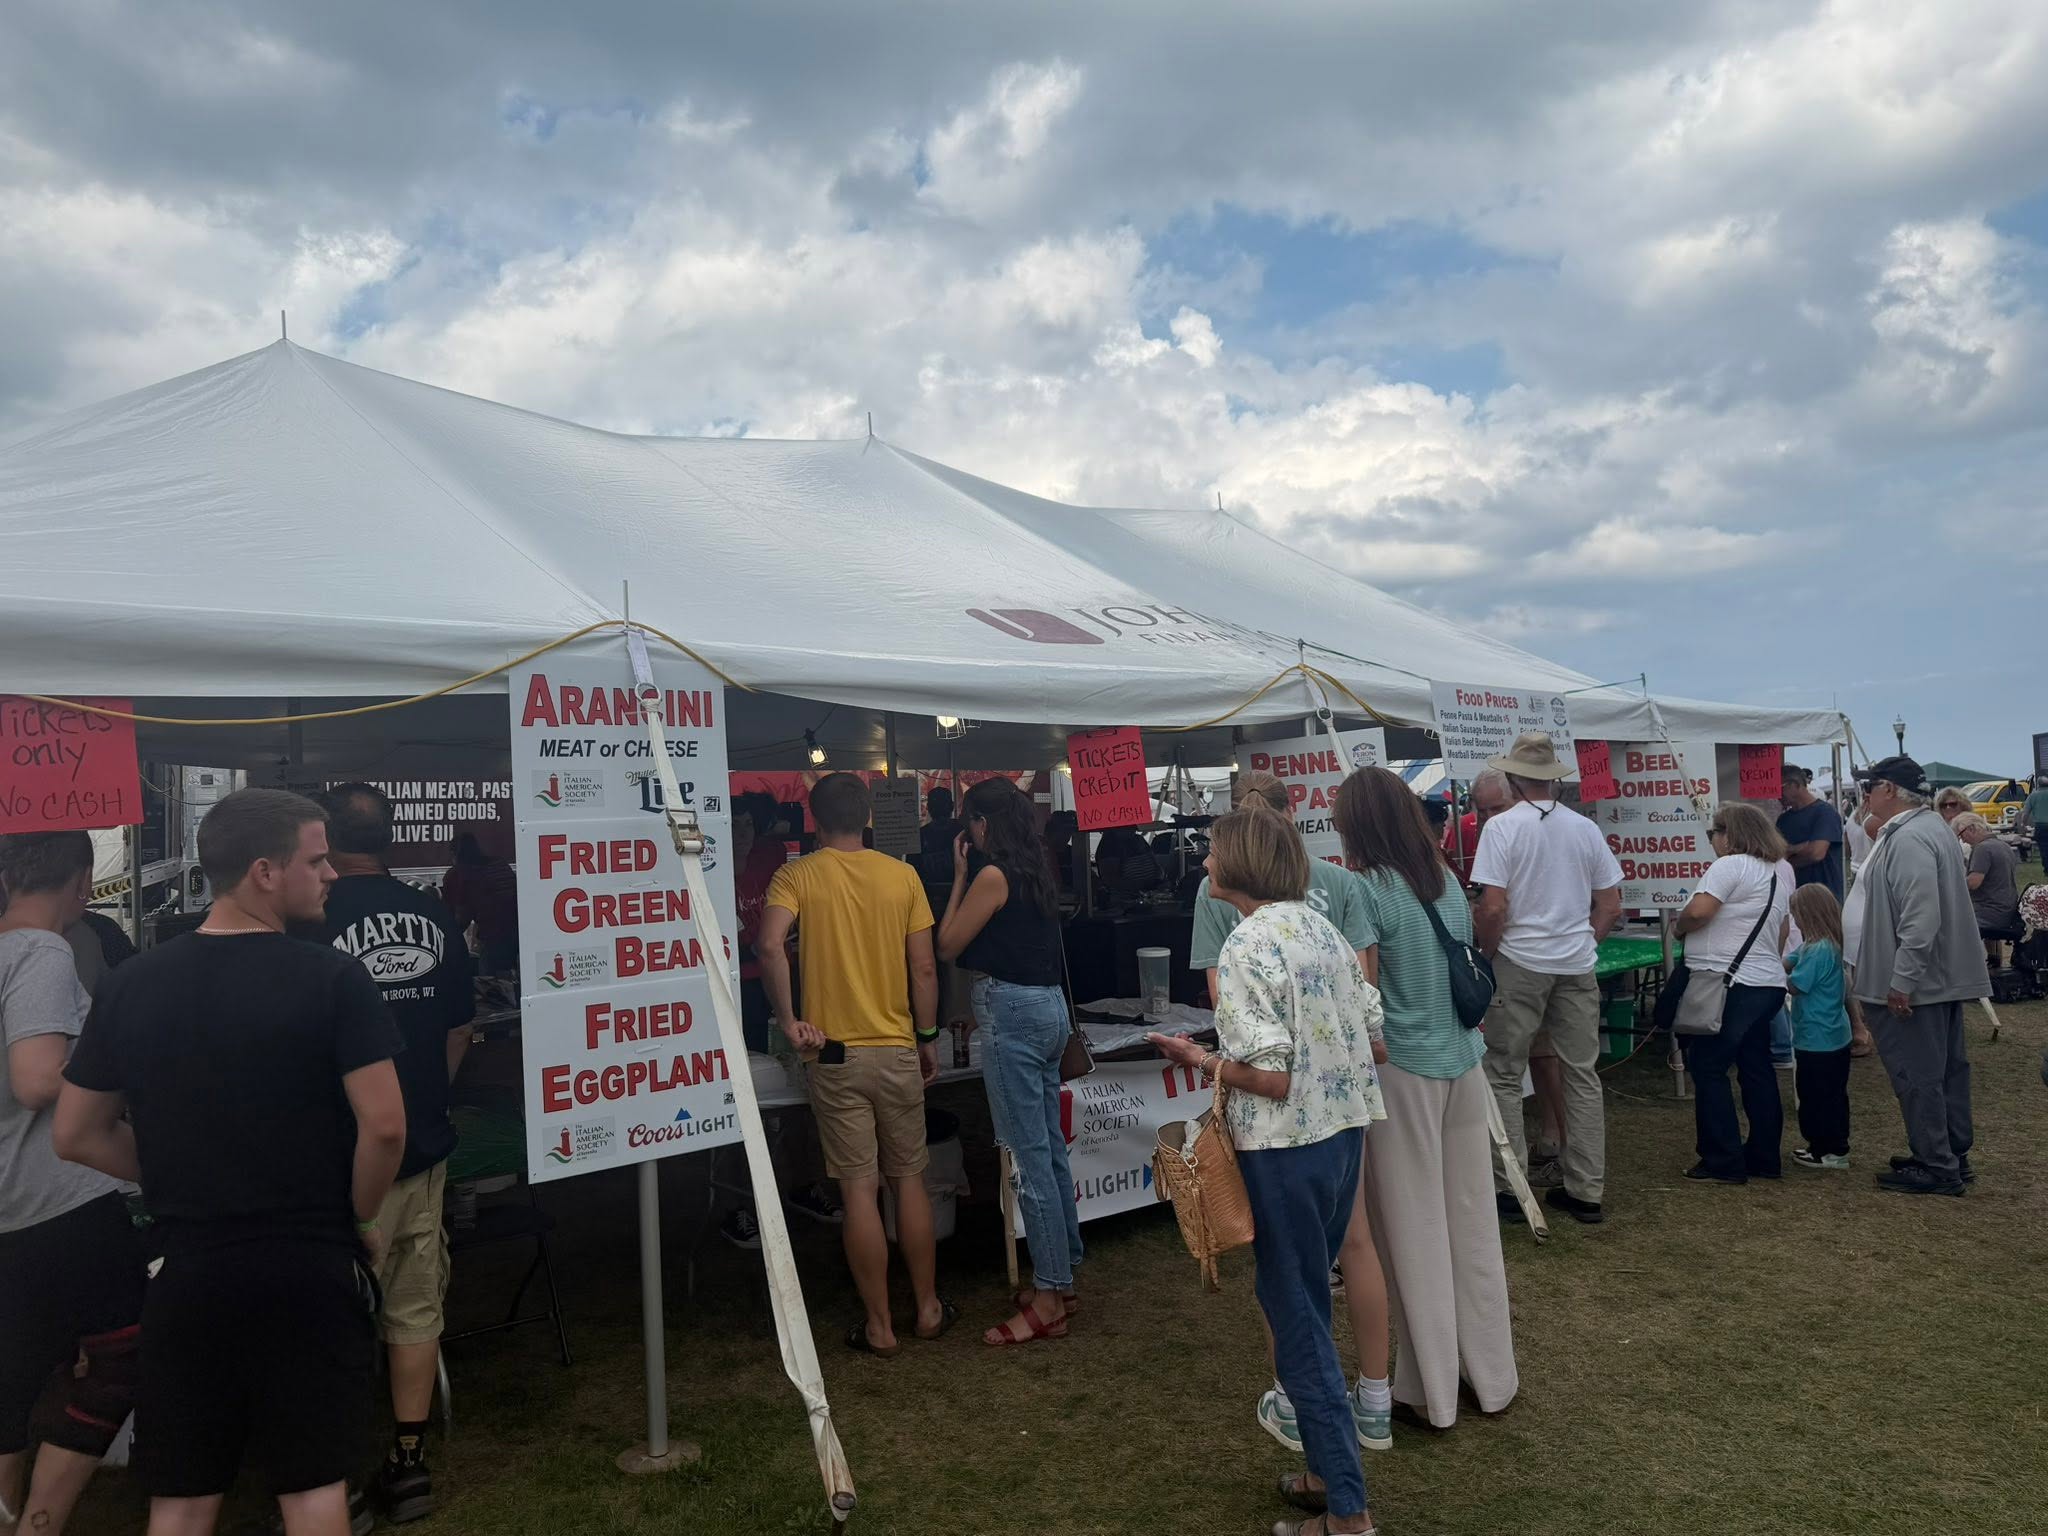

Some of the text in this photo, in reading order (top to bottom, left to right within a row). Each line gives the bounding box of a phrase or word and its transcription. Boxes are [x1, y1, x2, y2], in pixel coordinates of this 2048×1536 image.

[1456, 688, 1483, 706] FOOD
[1485, 692, 1519, 709] PRICES
[539, 739, 698, 758] MEAT or CHESE
[1074, 741, 1141, 768] TICKETS
[1251, 750, 1341, 778] PENNE
[482, 781, 513, 799] PAS
[639, 776, 695, 813] Lie
[1079, 771, 1140, 798] CREDIT
[41, 788, 123, 820] CASH
[1287, 784, 1341, 813] PAS
[390, 803, 501, 822] ANNED GOODS,
[1083, 805, 1143, 825] NO CASH
[1648, 812, 1680, 823] Coors
[1681, 813, 1711, 822] LIGT
[1606, 834, 1696, 856] SAUSAGE
[538, 834, 658, 880] FRIED
[553, 887, 692, 933] GREEN
[332, 912, 445, 964] MARTIN
[372, 952, 418, 976] Ford
[569, 953, 597, 963] ITALIAN
[569, 960, 608, 970] AMERICAN
[569, 968, 602, 977] SOCIETY
[422, 987, 435, 997] WI
[585, 1001, 692, 1050] FRIED
[541, 1048, 730, 1114] EGGPLANT
[1081, 1080, 1126, 1100] ITALIAN
[1083, 1095, 1146, 1117] AMERICAN
[576, 1125, 604, 1136] ITALIAN
[627, 1113, 735, 1148] Coors LIGHT
[1083, 1112, 1141, 1135] SOCIETY
[576, 1131, 615, 1143] AMERICAN
[576, 1140, 609, 1151] SOCIETY
[1085, 1168, 1140, 1200] LIGHT
